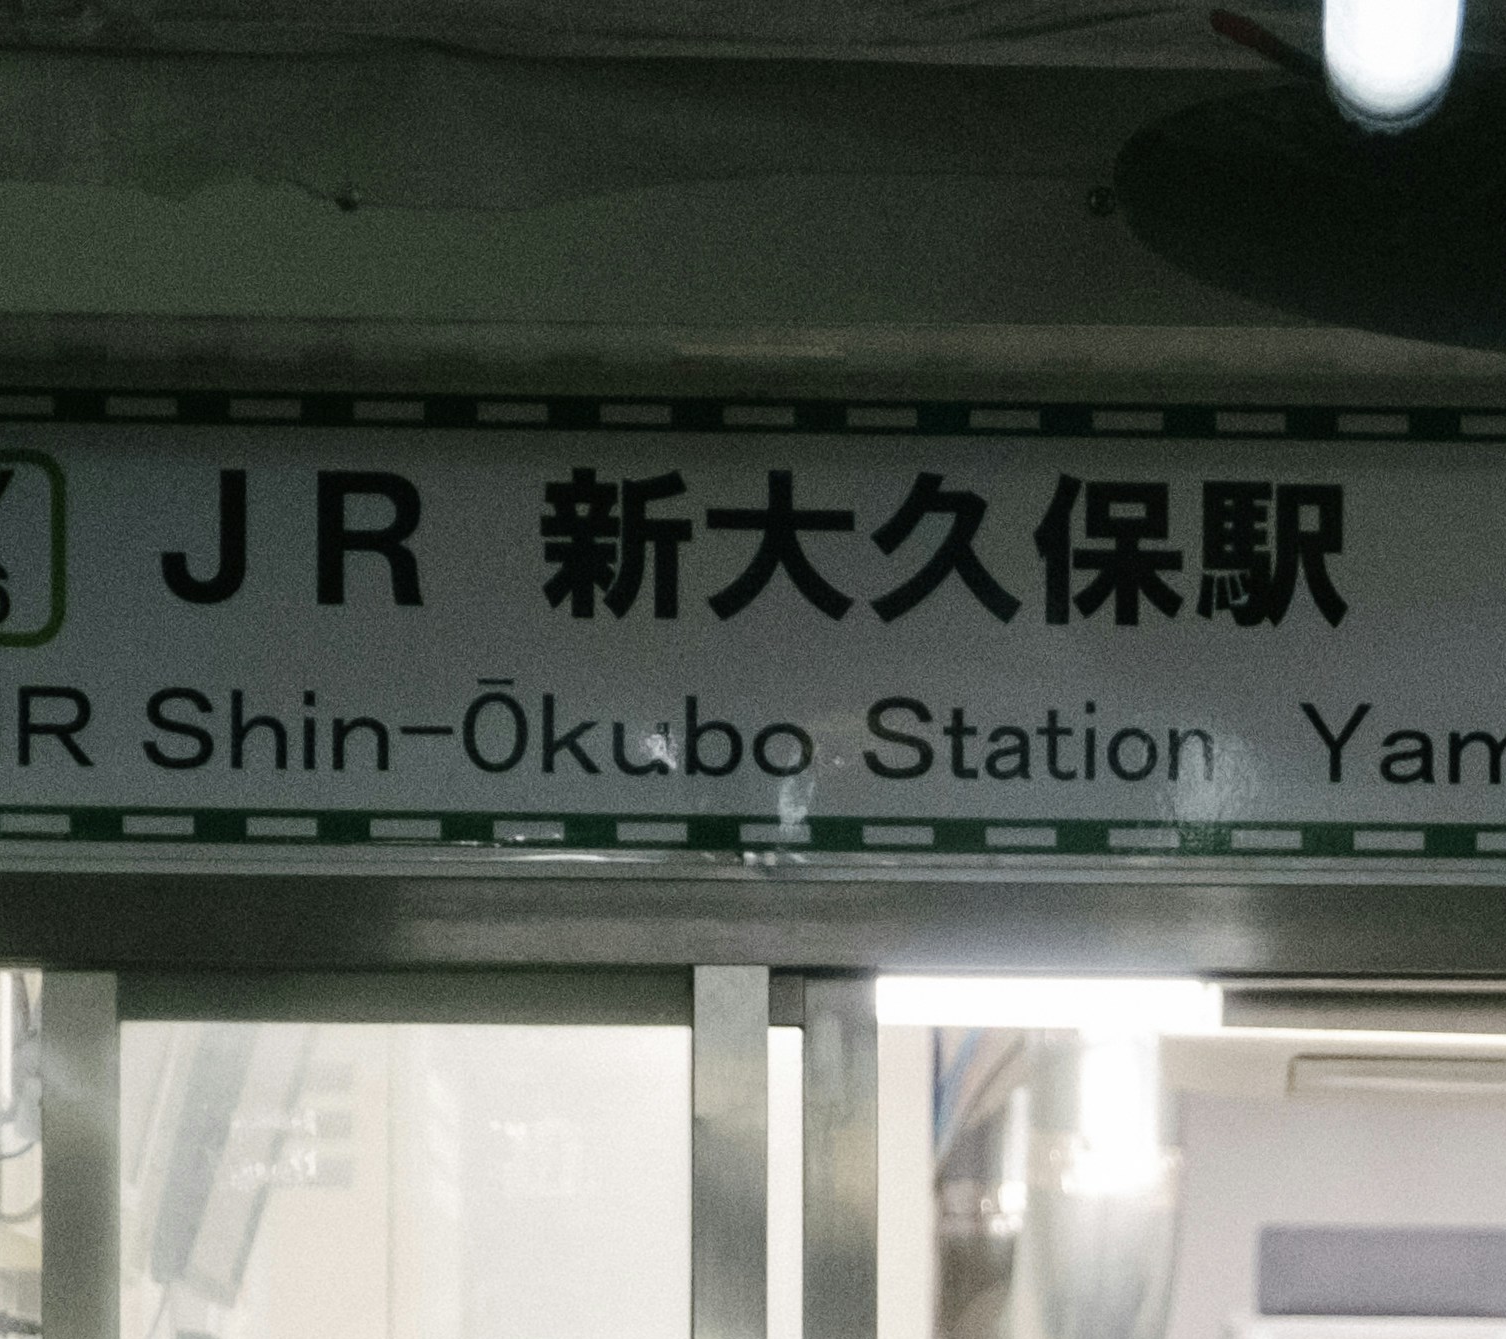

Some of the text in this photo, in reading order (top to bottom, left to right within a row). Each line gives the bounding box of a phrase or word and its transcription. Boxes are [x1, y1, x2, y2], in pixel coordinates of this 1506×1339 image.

[160, 468, 424, 607] JR
[540, 466, 1350, 630] 新大久保駅
[863, 696, 1218, 786] Station
